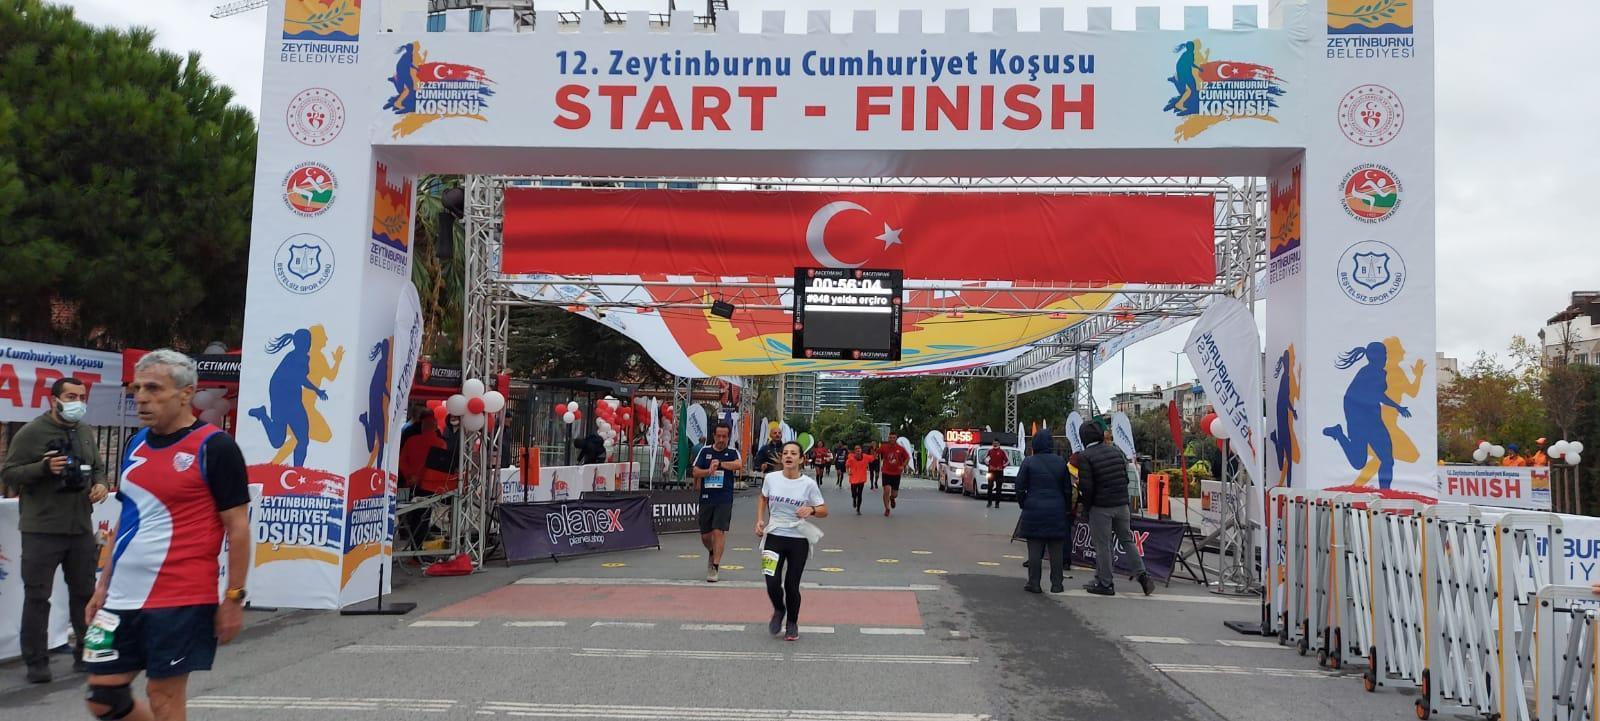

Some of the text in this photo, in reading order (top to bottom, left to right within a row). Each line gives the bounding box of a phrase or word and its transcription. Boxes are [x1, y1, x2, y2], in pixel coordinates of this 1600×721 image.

[281, 42, 359, 54] ZEYTİNBURNU
[1327, 36, 1414, 48] ZEYTİNBURNU
[280, 53, 359, 64] BELEDİYESİ
[1326, 48, 1415, 59] BELEDİYESİ
[556, 48, 1095, 83] 12. Zeytinburnu Cumhuriyet Koşusu
[415, 90, 479, 100] CUMHURİYET
[1199, 89, 1268, 100] CUMHURİYET
[415, 100, 480, 119] KOŞUSU
[553, 84, 778, 131] START
[855, 83, 1095, 131] FINISH
[1199, 100, 1269, 121] KOŞUSU
[1377, 266, 1382, 274] T
[1369, 292, 1389, 303] SPOR
[6, 346, 68, 366] Cumhuriyet
[69, 354, 104, 370] Koşusu
[1447, 477, 1521, 499] FINISH
[546, 503, 624, 545] planex
